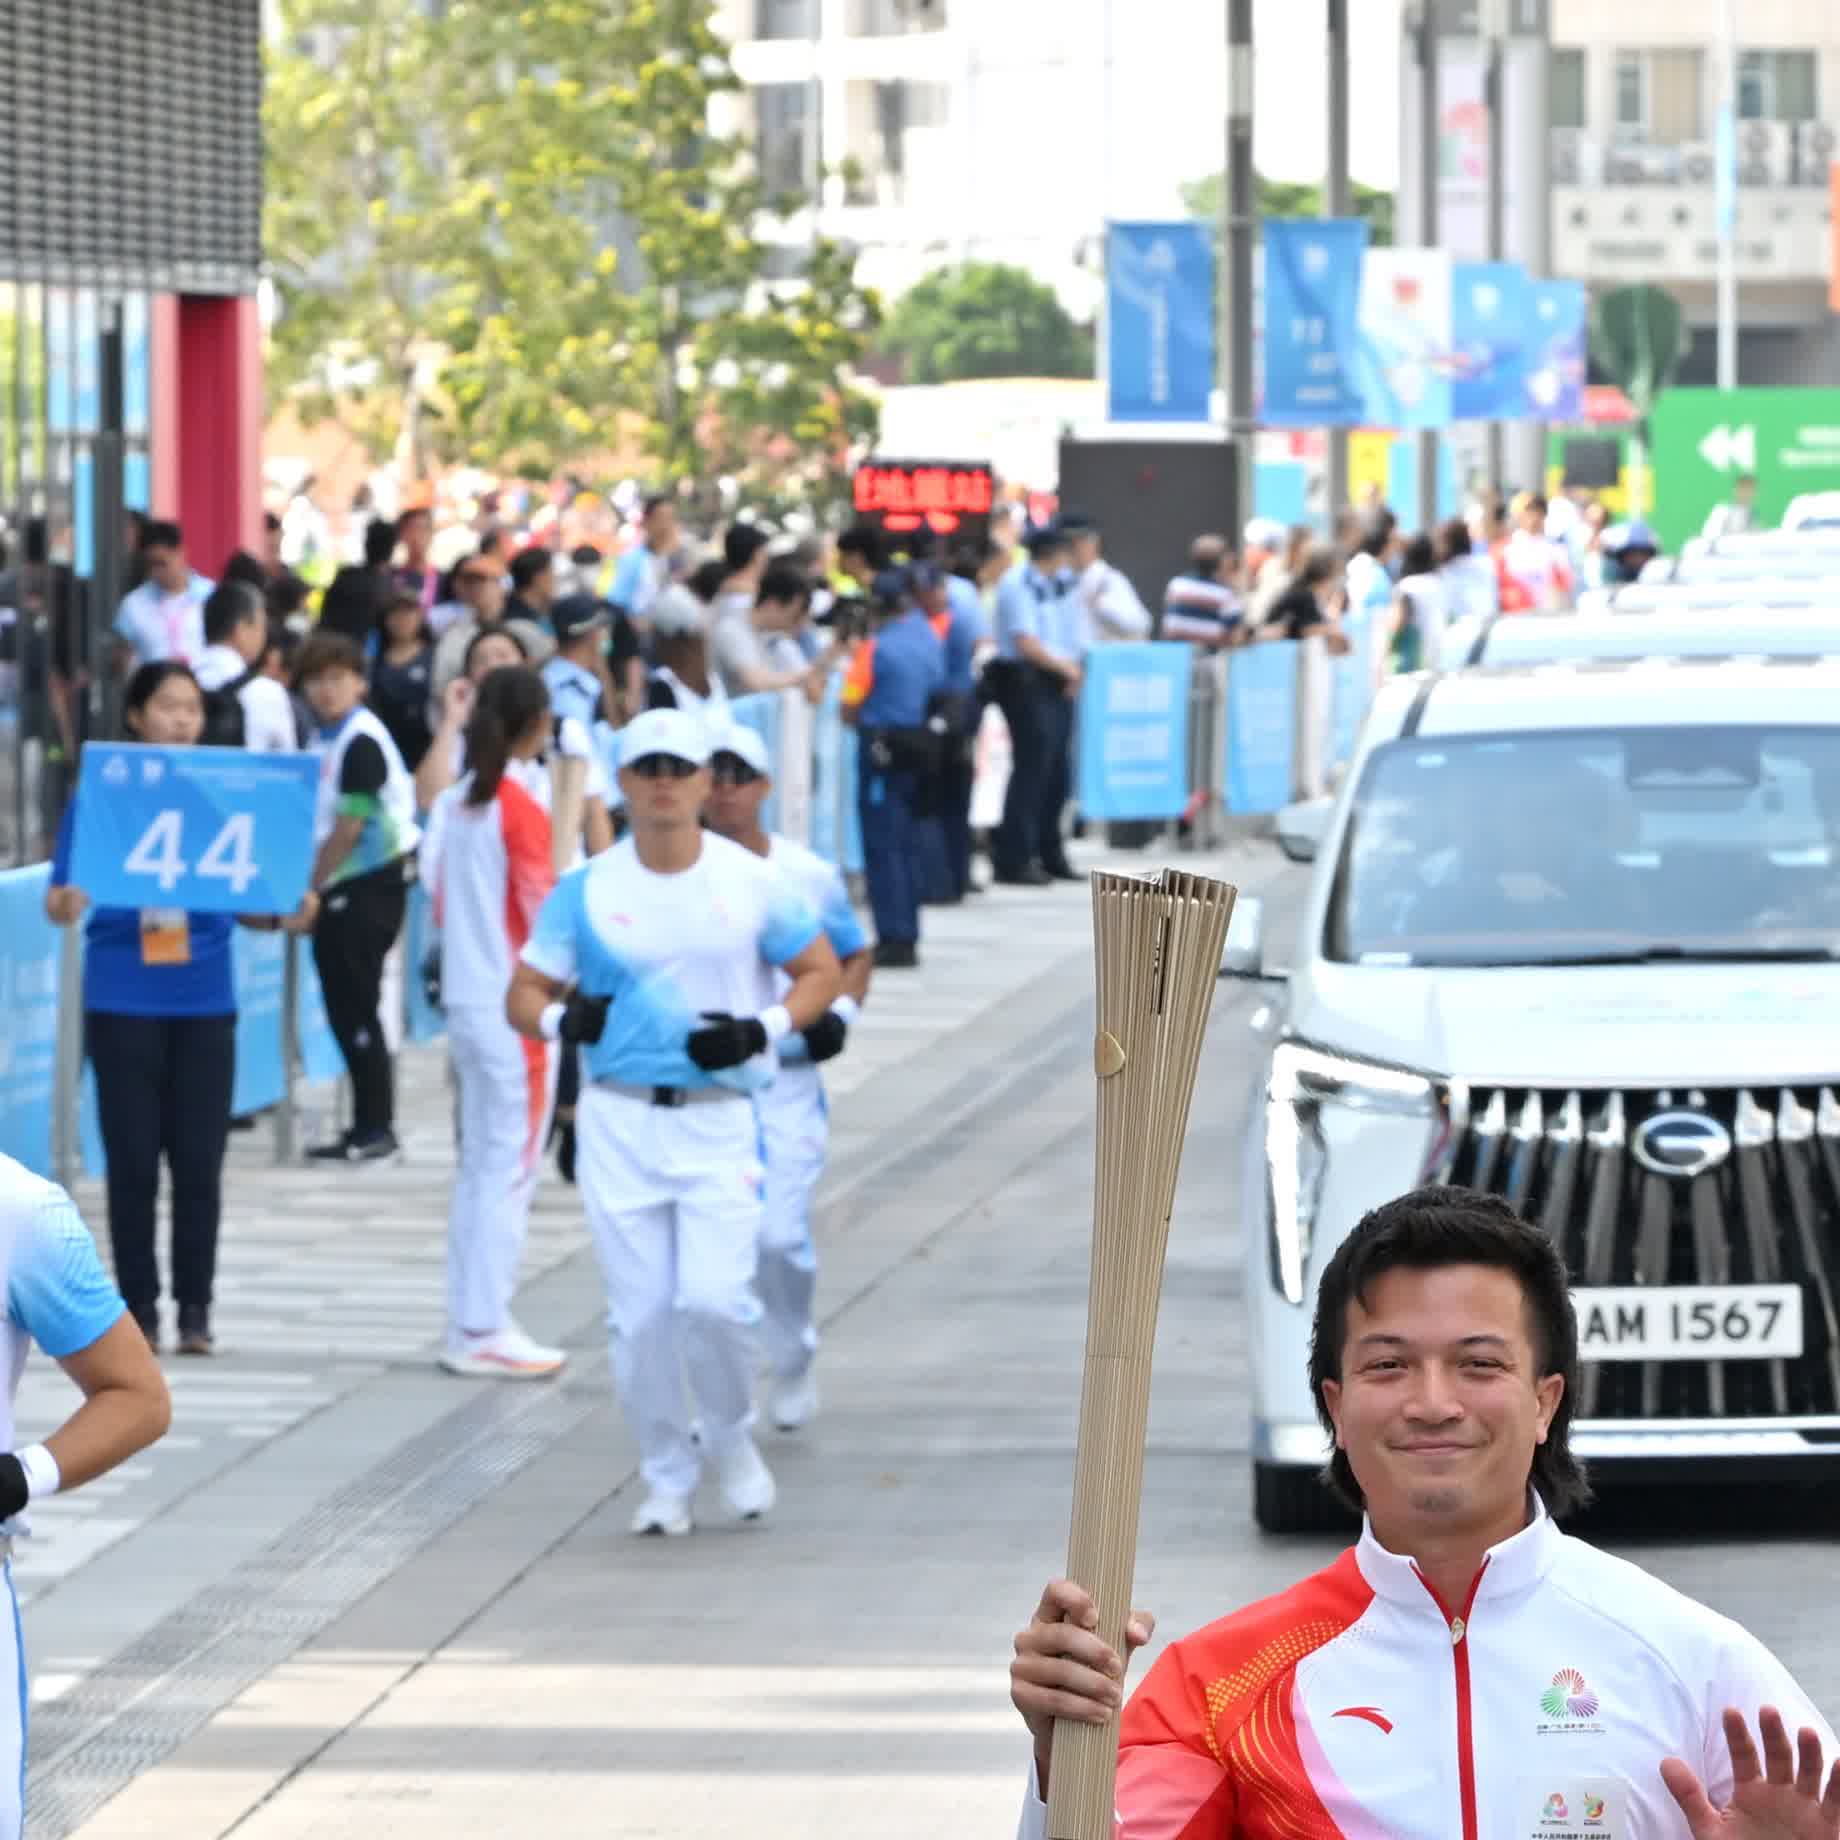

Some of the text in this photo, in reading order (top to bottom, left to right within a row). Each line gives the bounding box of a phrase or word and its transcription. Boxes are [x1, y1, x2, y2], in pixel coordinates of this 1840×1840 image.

[122, 809, 261, 895] 44
[1583, 1299, 1785, 1343] AM 1567
